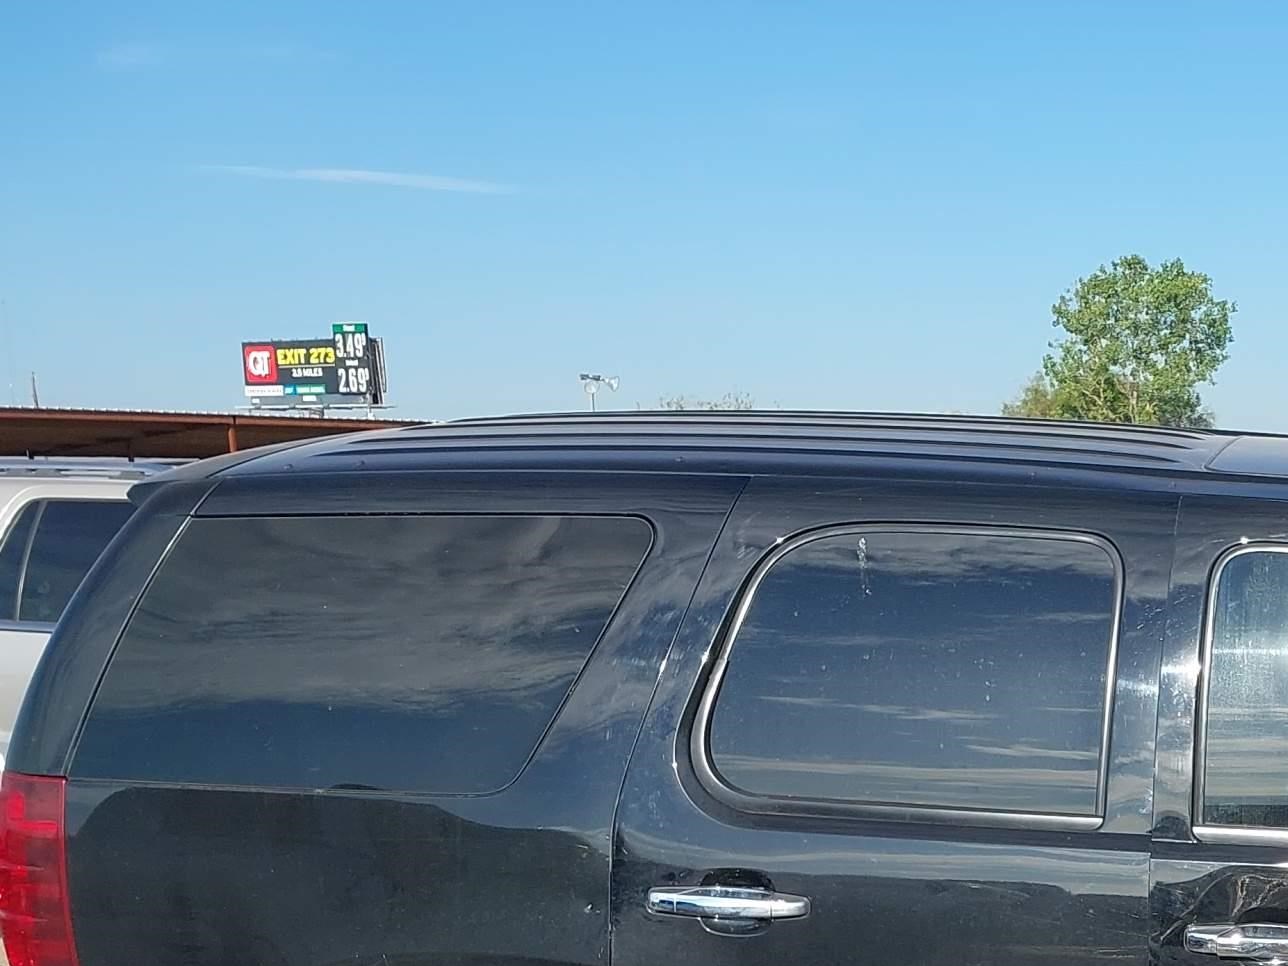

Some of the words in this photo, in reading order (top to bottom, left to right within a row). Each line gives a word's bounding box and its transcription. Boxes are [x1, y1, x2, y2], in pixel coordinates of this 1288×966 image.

[248, 351, 270, 377] QT
[276, 349, 306, 365] EXIT
[309, 347, 336, 365] 273
